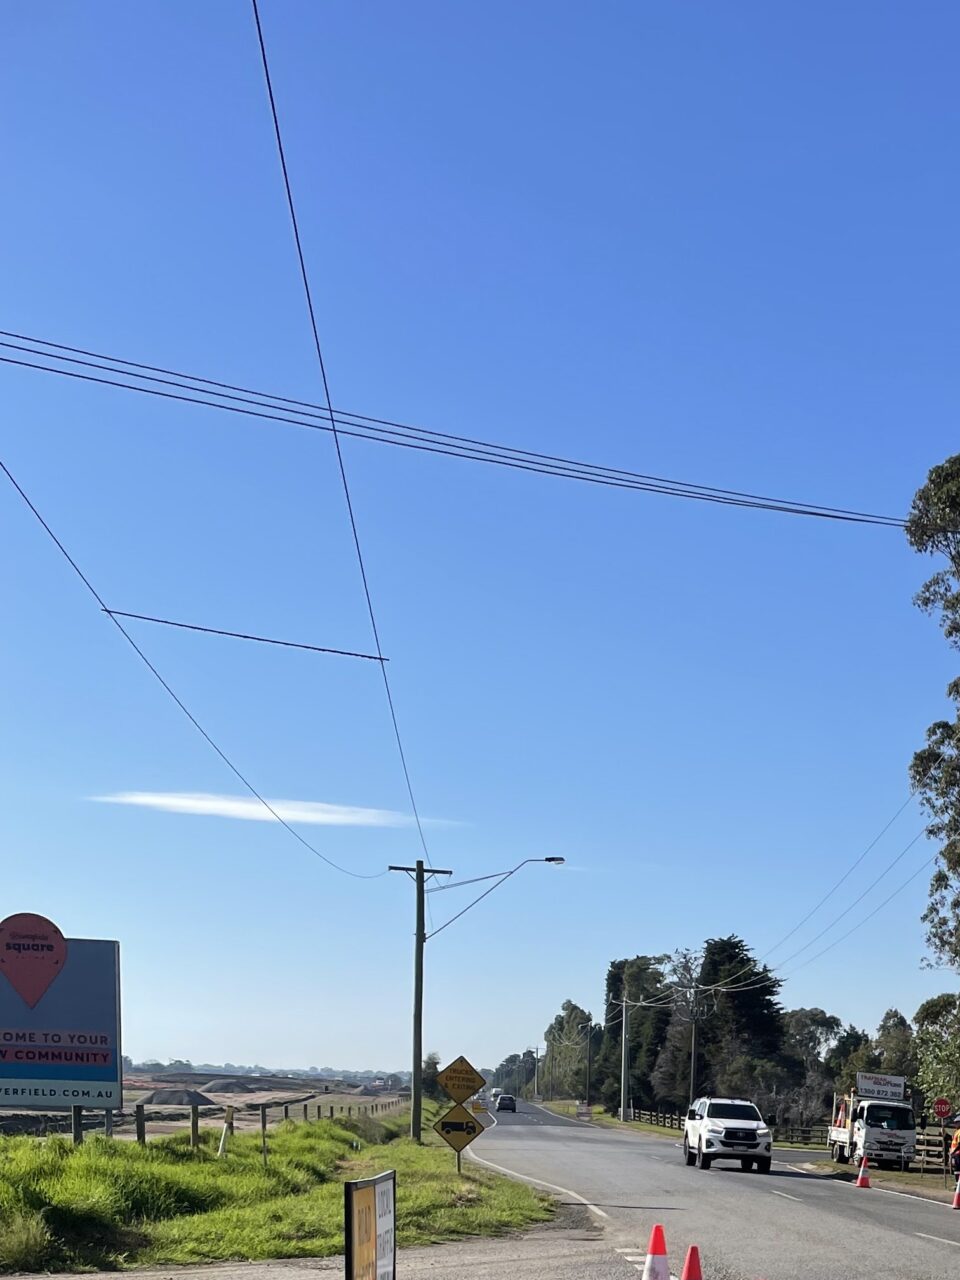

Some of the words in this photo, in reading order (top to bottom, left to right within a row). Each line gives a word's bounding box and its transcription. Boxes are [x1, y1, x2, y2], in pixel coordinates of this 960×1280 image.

[5, 942, 54, 954] square
[2, 1032, 36, 1043] OME
[42, 1033, 62, 1044] TO
[68, 1034, 109, 1046] YOUR
[15, 1050, 109, 1063] COMMUNITY
[934, 1104, 950, 1112] STOP
